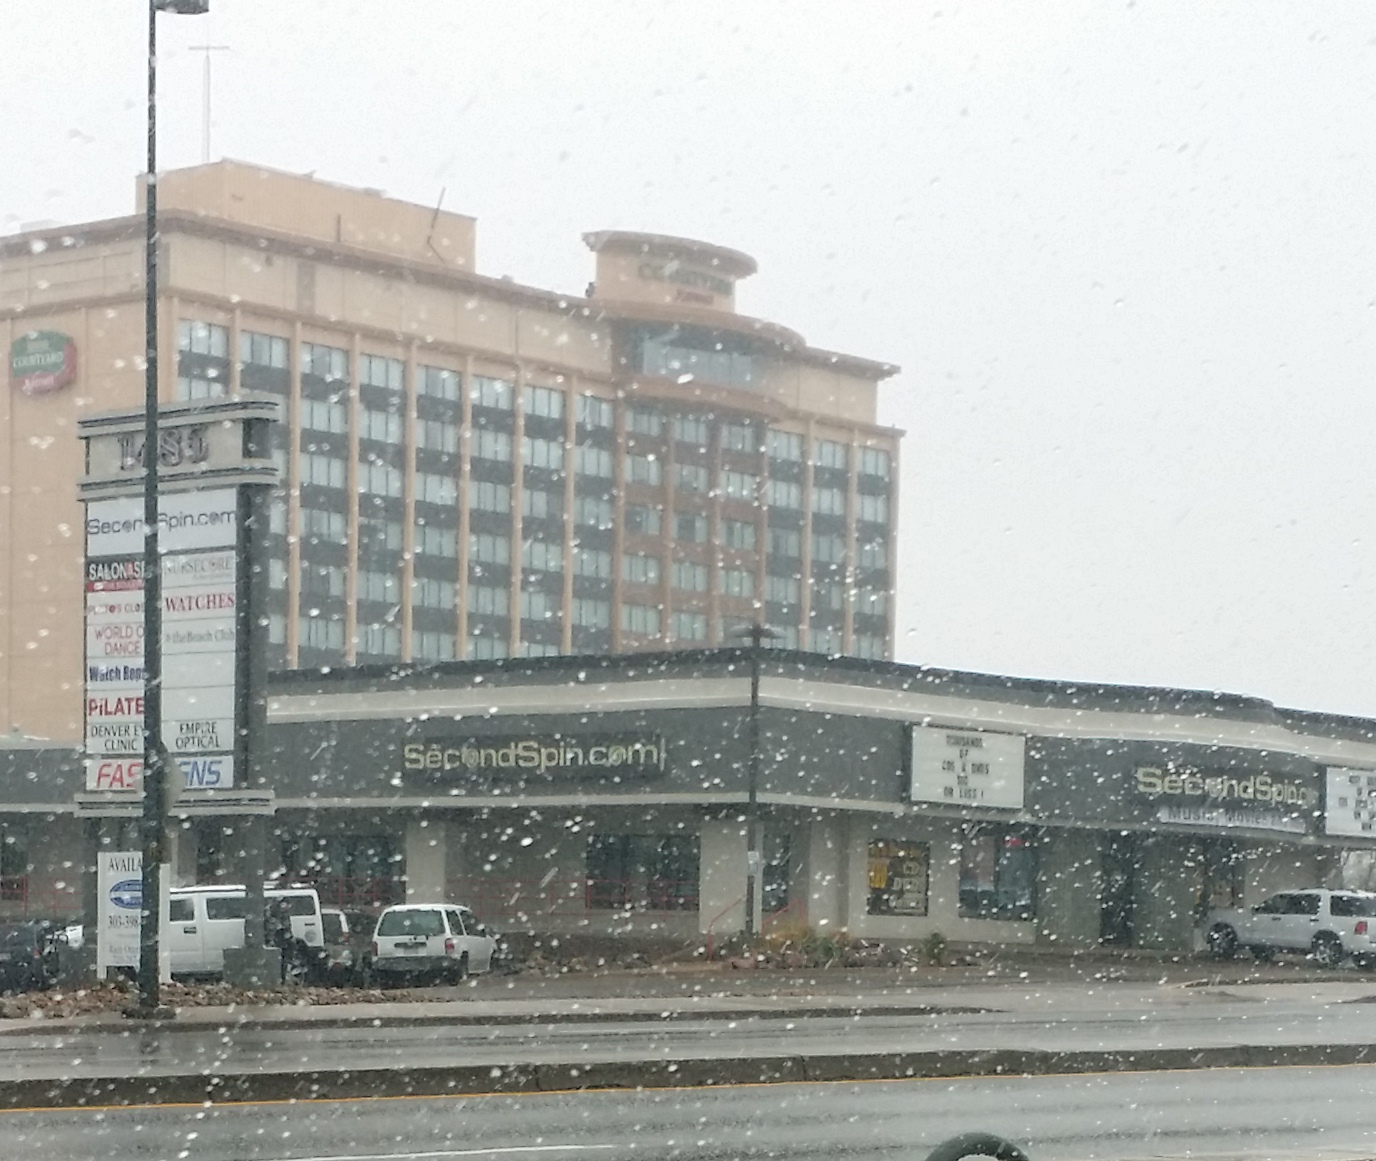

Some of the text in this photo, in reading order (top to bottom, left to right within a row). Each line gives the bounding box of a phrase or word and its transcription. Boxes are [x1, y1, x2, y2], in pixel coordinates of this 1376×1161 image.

[88, 510, 236, 536] SeconSpin.com
[165, 593, 234, 612] WATCHES
[95, 625, 132, 640] WORLD
[105, 641, 141, 655] DANCE
[90, 665, 121, 682] Watch
[89, 697, 144, 716] PiLATE
[91, 726, 130, 737] DENVER
[180, 722, 217, 734] EMPIRE
[105, 739, 138, 751] CLINIC
[175, 735, 219, 749] OPTICAL
[404, 741, 658, 773] SecondSpin.com
[97, 762, 144, 789] FAS
